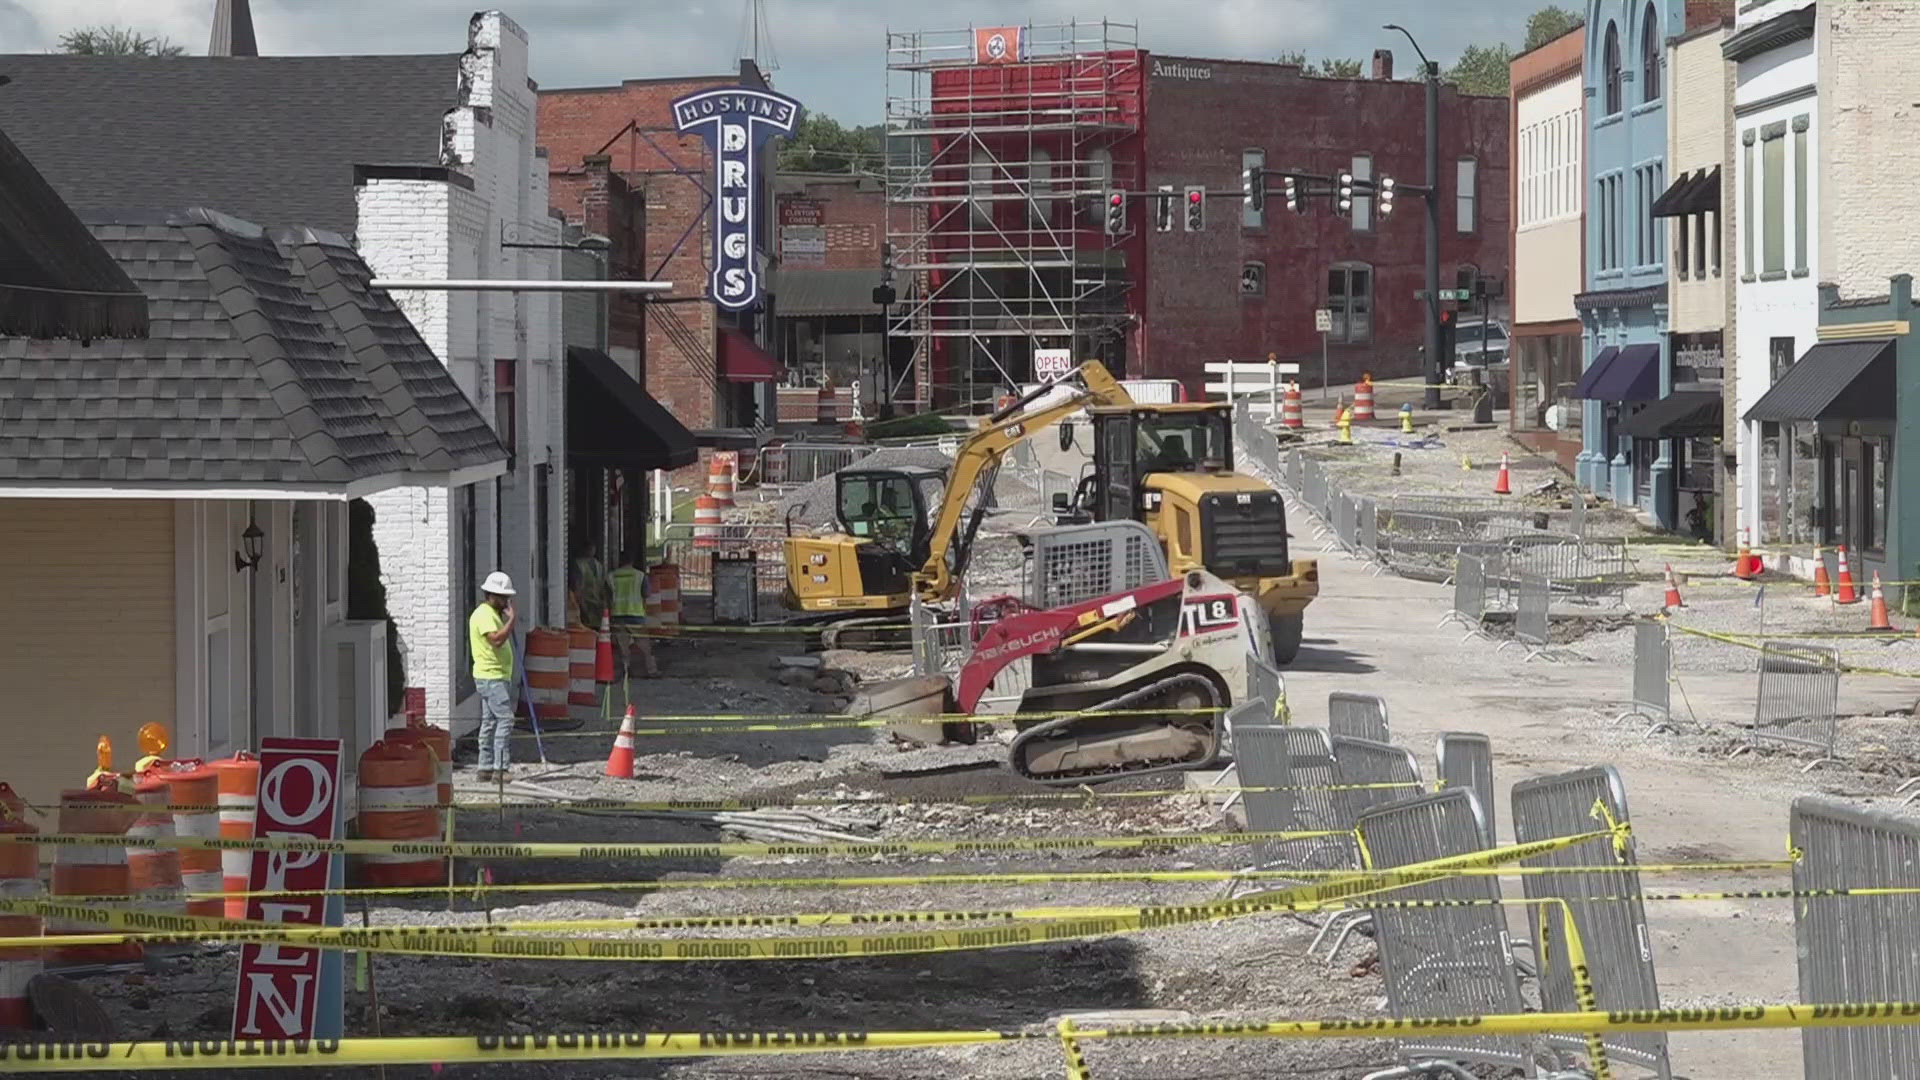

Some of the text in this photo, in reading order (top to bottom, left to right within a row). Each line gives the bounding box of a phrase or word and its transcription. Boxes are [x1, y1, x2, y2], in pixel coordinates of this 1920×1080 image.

[1152, 60, 1211, 81] Antiques
[683, 96, 789, 121] HOSKINS
[722, 123, 747, 297] DRUGS
[1037, 356, 1069, 370] OPEN
[810, 554, 824, 565] CAT
[1182, 601, 1239, 637] TL8
[241, 757, 334, 1036] OPEN
